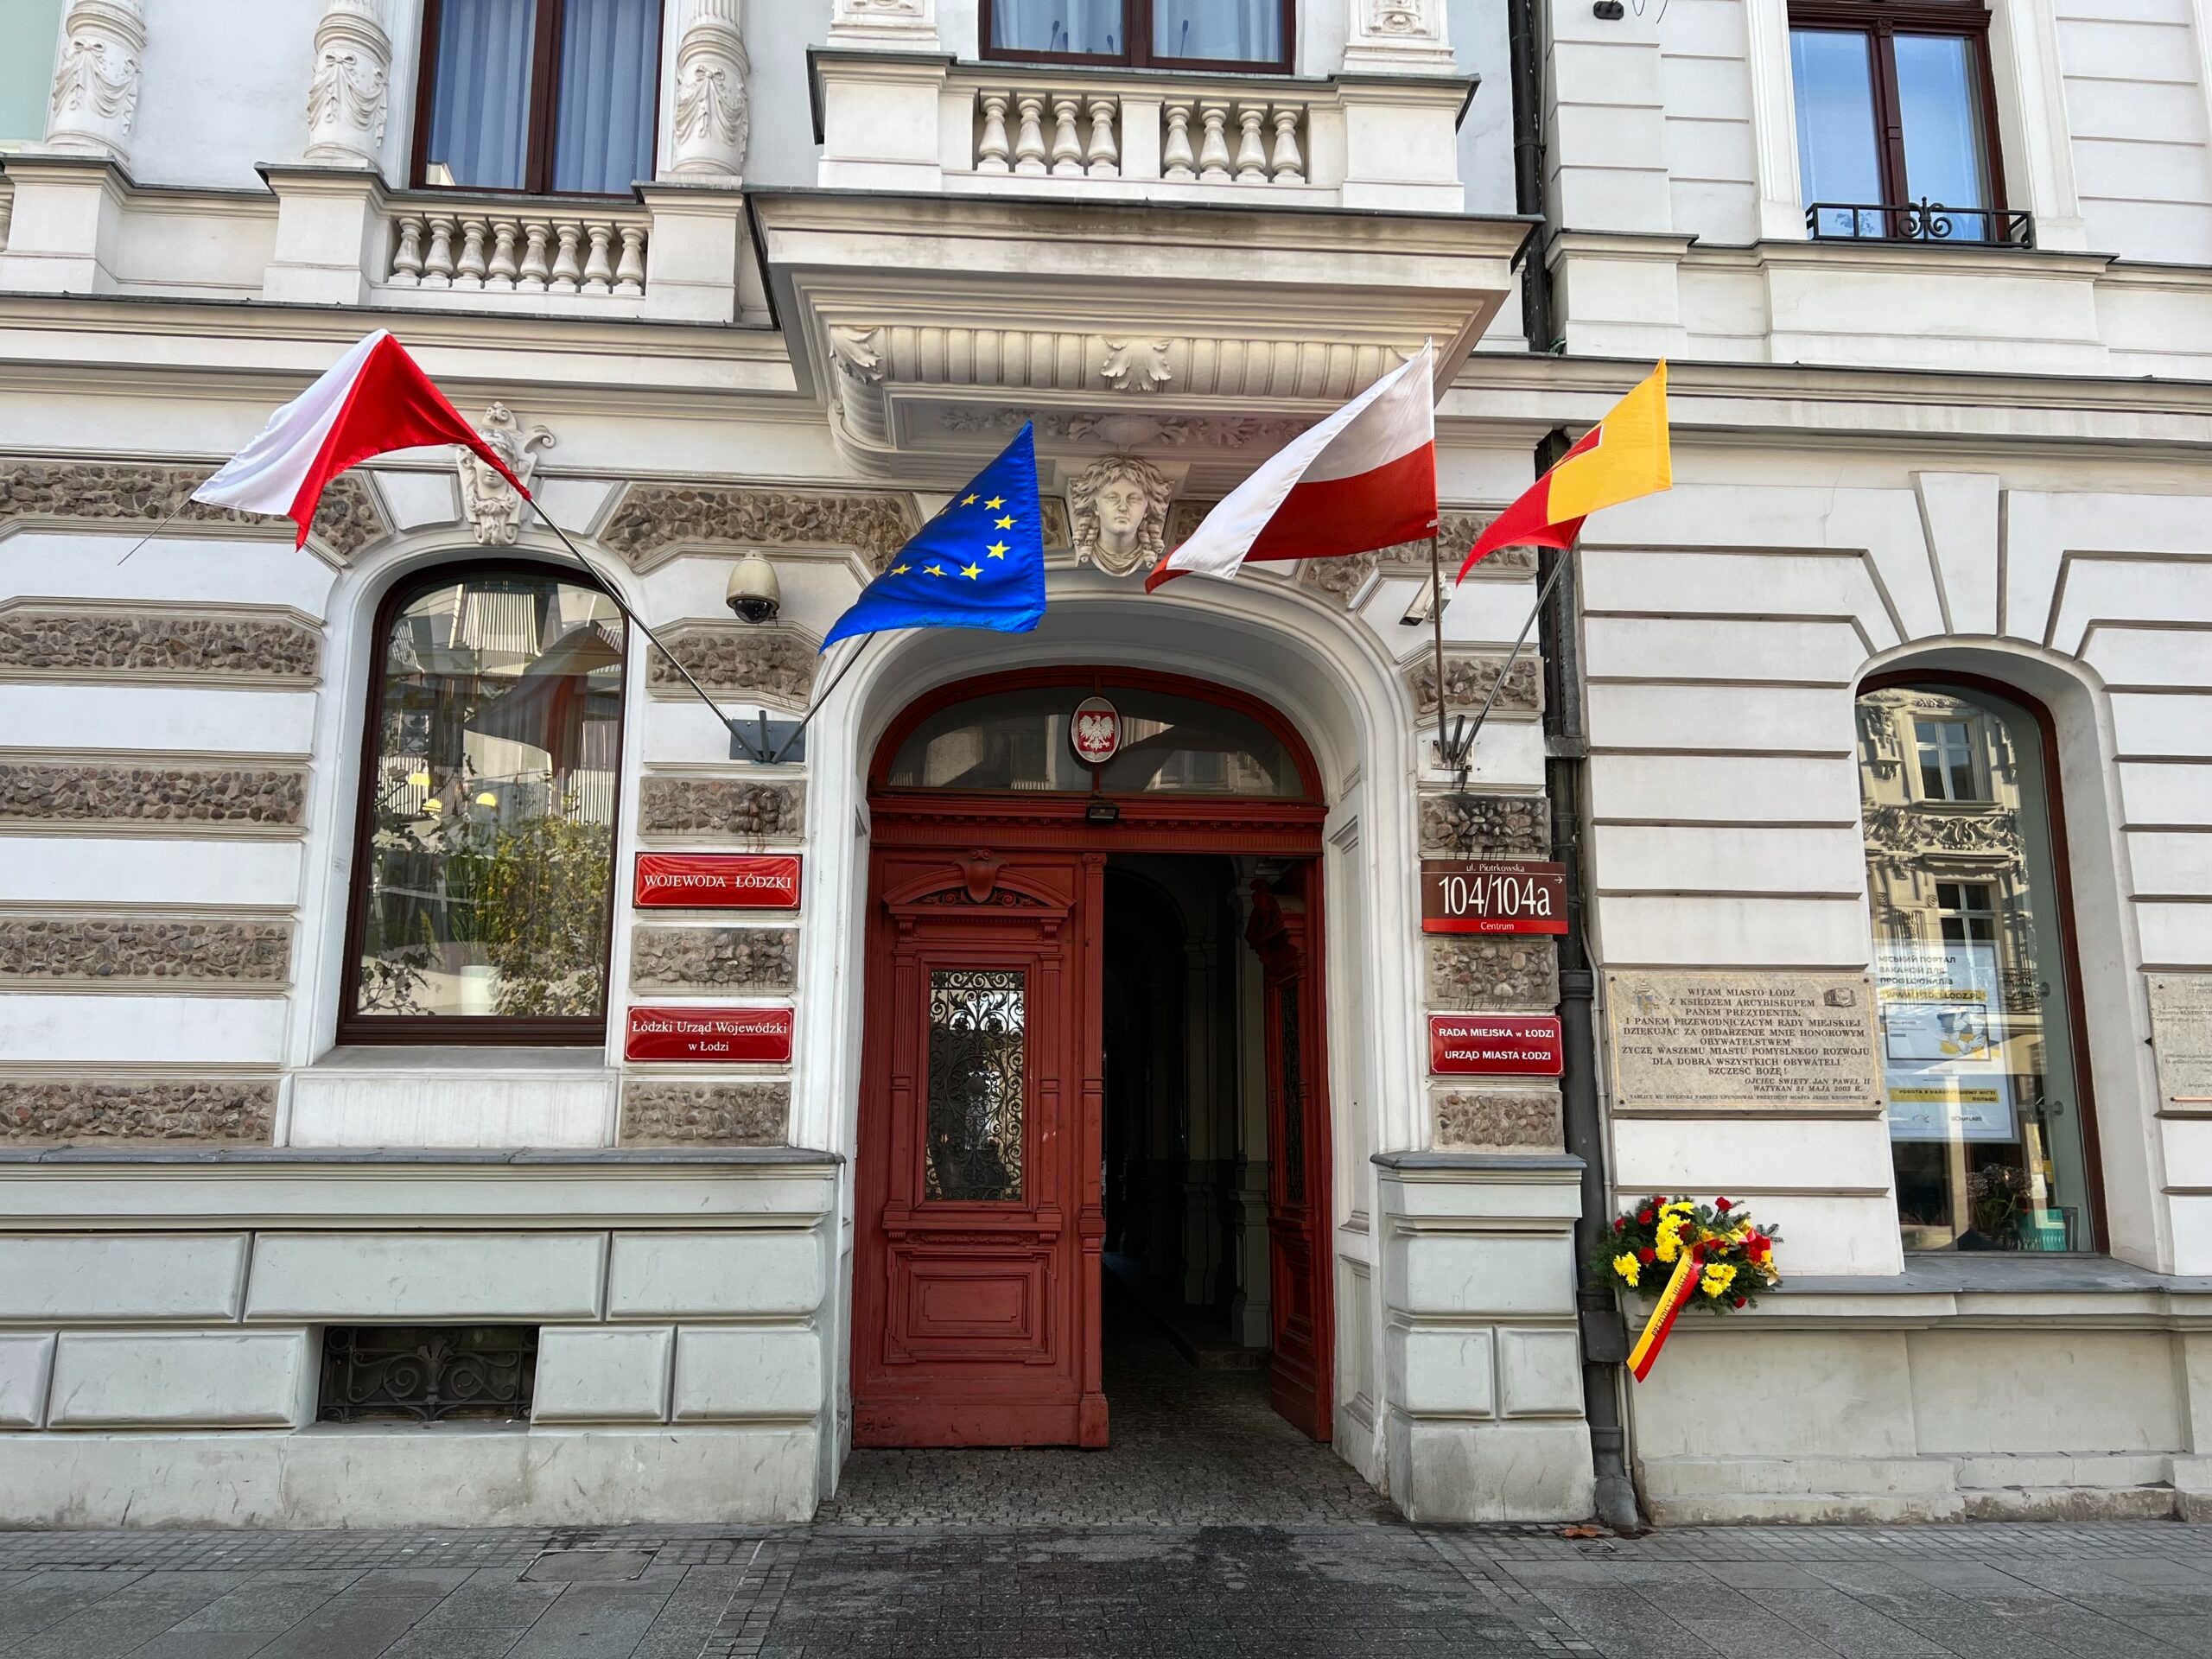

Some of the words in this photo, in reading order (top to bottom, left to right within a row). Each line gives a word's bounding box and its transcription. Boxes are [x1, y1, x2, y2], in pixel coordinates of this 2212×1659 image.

[1478, 863, 1525, 873] Piotrkowska
[644, 875, 727, 888] WOJEWODA
[735, 873, 791, 889] ŁÓDZKI
[1438, 874, 1553, 918] 104/104a
[1480, 921, 1515, 931] Centrum
[1688, 988, 1721, 996] WITAM
[1726, 988, 1764, 997] MIASTO
[1737, 999, 1815, 1007] ARCYBISKUPEM
[1726, 1008, 1802, 1017] PREZYDENTEM
[1635, 1017, 1669, 1026] PANEM
[1808, 1019, 1861, 1027] MIEJSKIEJ
[632, 1020, 673, 1033] Łódzki
[677, 1021, 712, 1035] Urząd
[715, 1022, 787, 1036] Wojewódzki
[1439, 1028, 1468, 1037] RADA
[1470, 1028, 1514, 1038] MIEJSKA
[1525, 1029, 1554, 1038] ŁODZI
[1684, 1027, 1696, 1036] ZA
[688, 1042, 697, 1051] w
[700, 1040, 729, 1052] Łodzi
[1700, 1038, 1791, 1046] OBYWATELSTWEM
[1445, 1050, 1480, 1061] URZĄD
[1482, 1051, 1520, 1059] MIASTA
[1522, 1051, 1551, 1060] ŁODZI
[1658, 1046, 1705, 1055] WASZEMU
[1716, 1058, 1778, 1066] WSZYSTKICH
